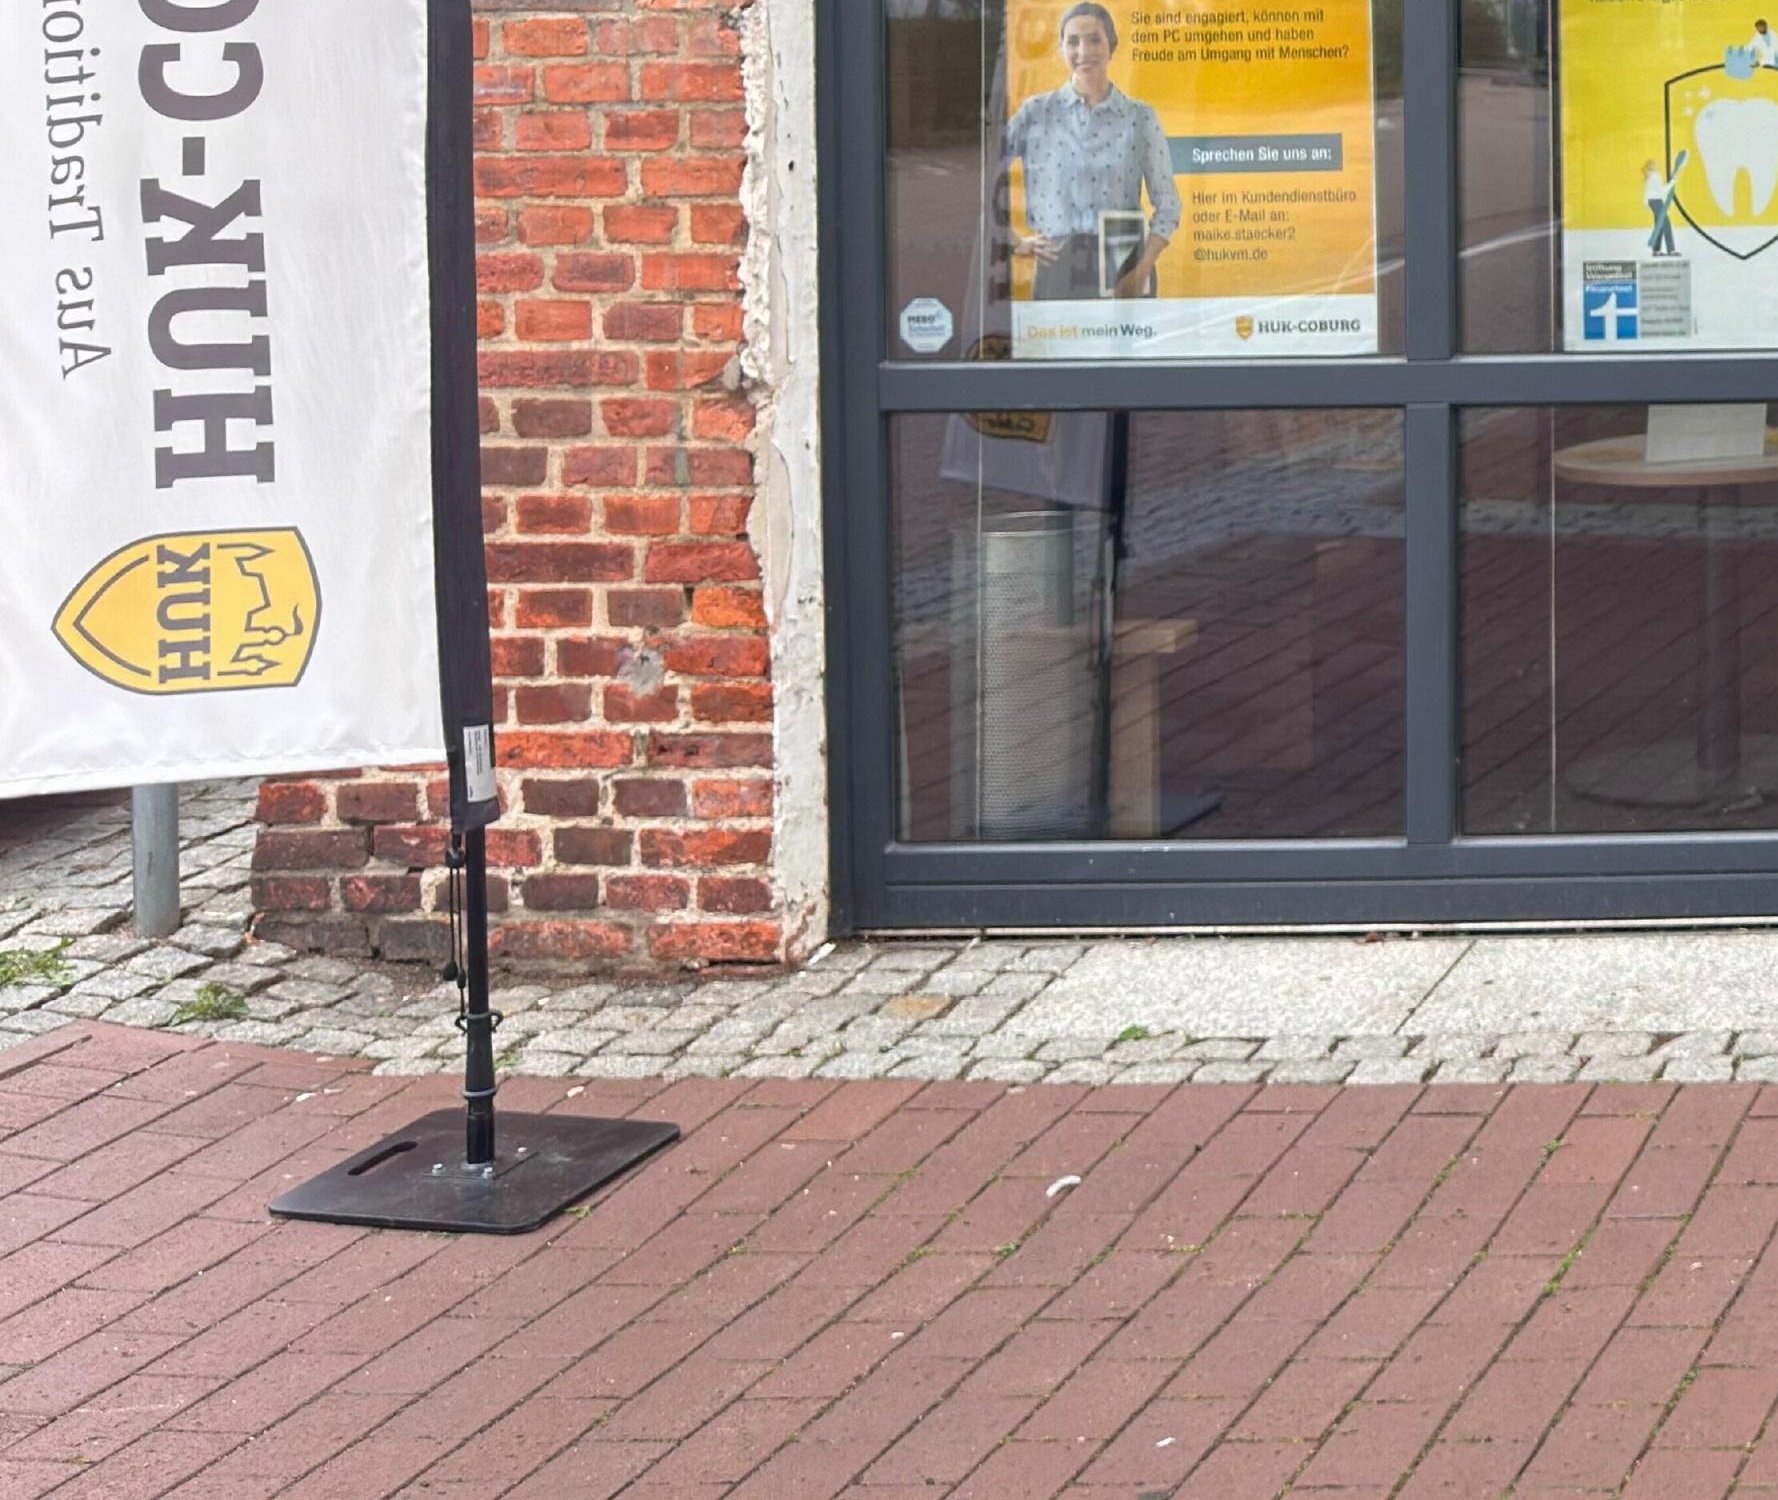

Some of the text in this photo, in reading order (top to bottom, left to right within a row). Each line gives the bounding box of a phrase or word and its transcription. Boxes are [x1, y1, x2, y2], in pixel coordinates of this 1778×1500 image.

[1131, 12, 1150, 24] Sie
[1155, 11, 1181, 24] sind
[1253, 9, 1299, 22] können
[1304, 9, 1324, 21] mit
[1132, 28, 1314, 44] dem PC umgehen und haben
[1132, 48, 1173, 61] Freude
[1178, 51, 1196, 61] am
[1201, 47, 1251, 63] Umgang
[1256, 47, 1275, 59] mit
[1192, 145, 1332, 166] Sprechen Sie uns an:
[1192, 188, 1357, 204] Hier im Kundendienstbüro
[1192, 208, 1290, 223] oder E-Mail an:
[1028, 324, 1157, 339] Das ist mein Weg.
[1258, 319, 1361, 333] HUK-COBURG
